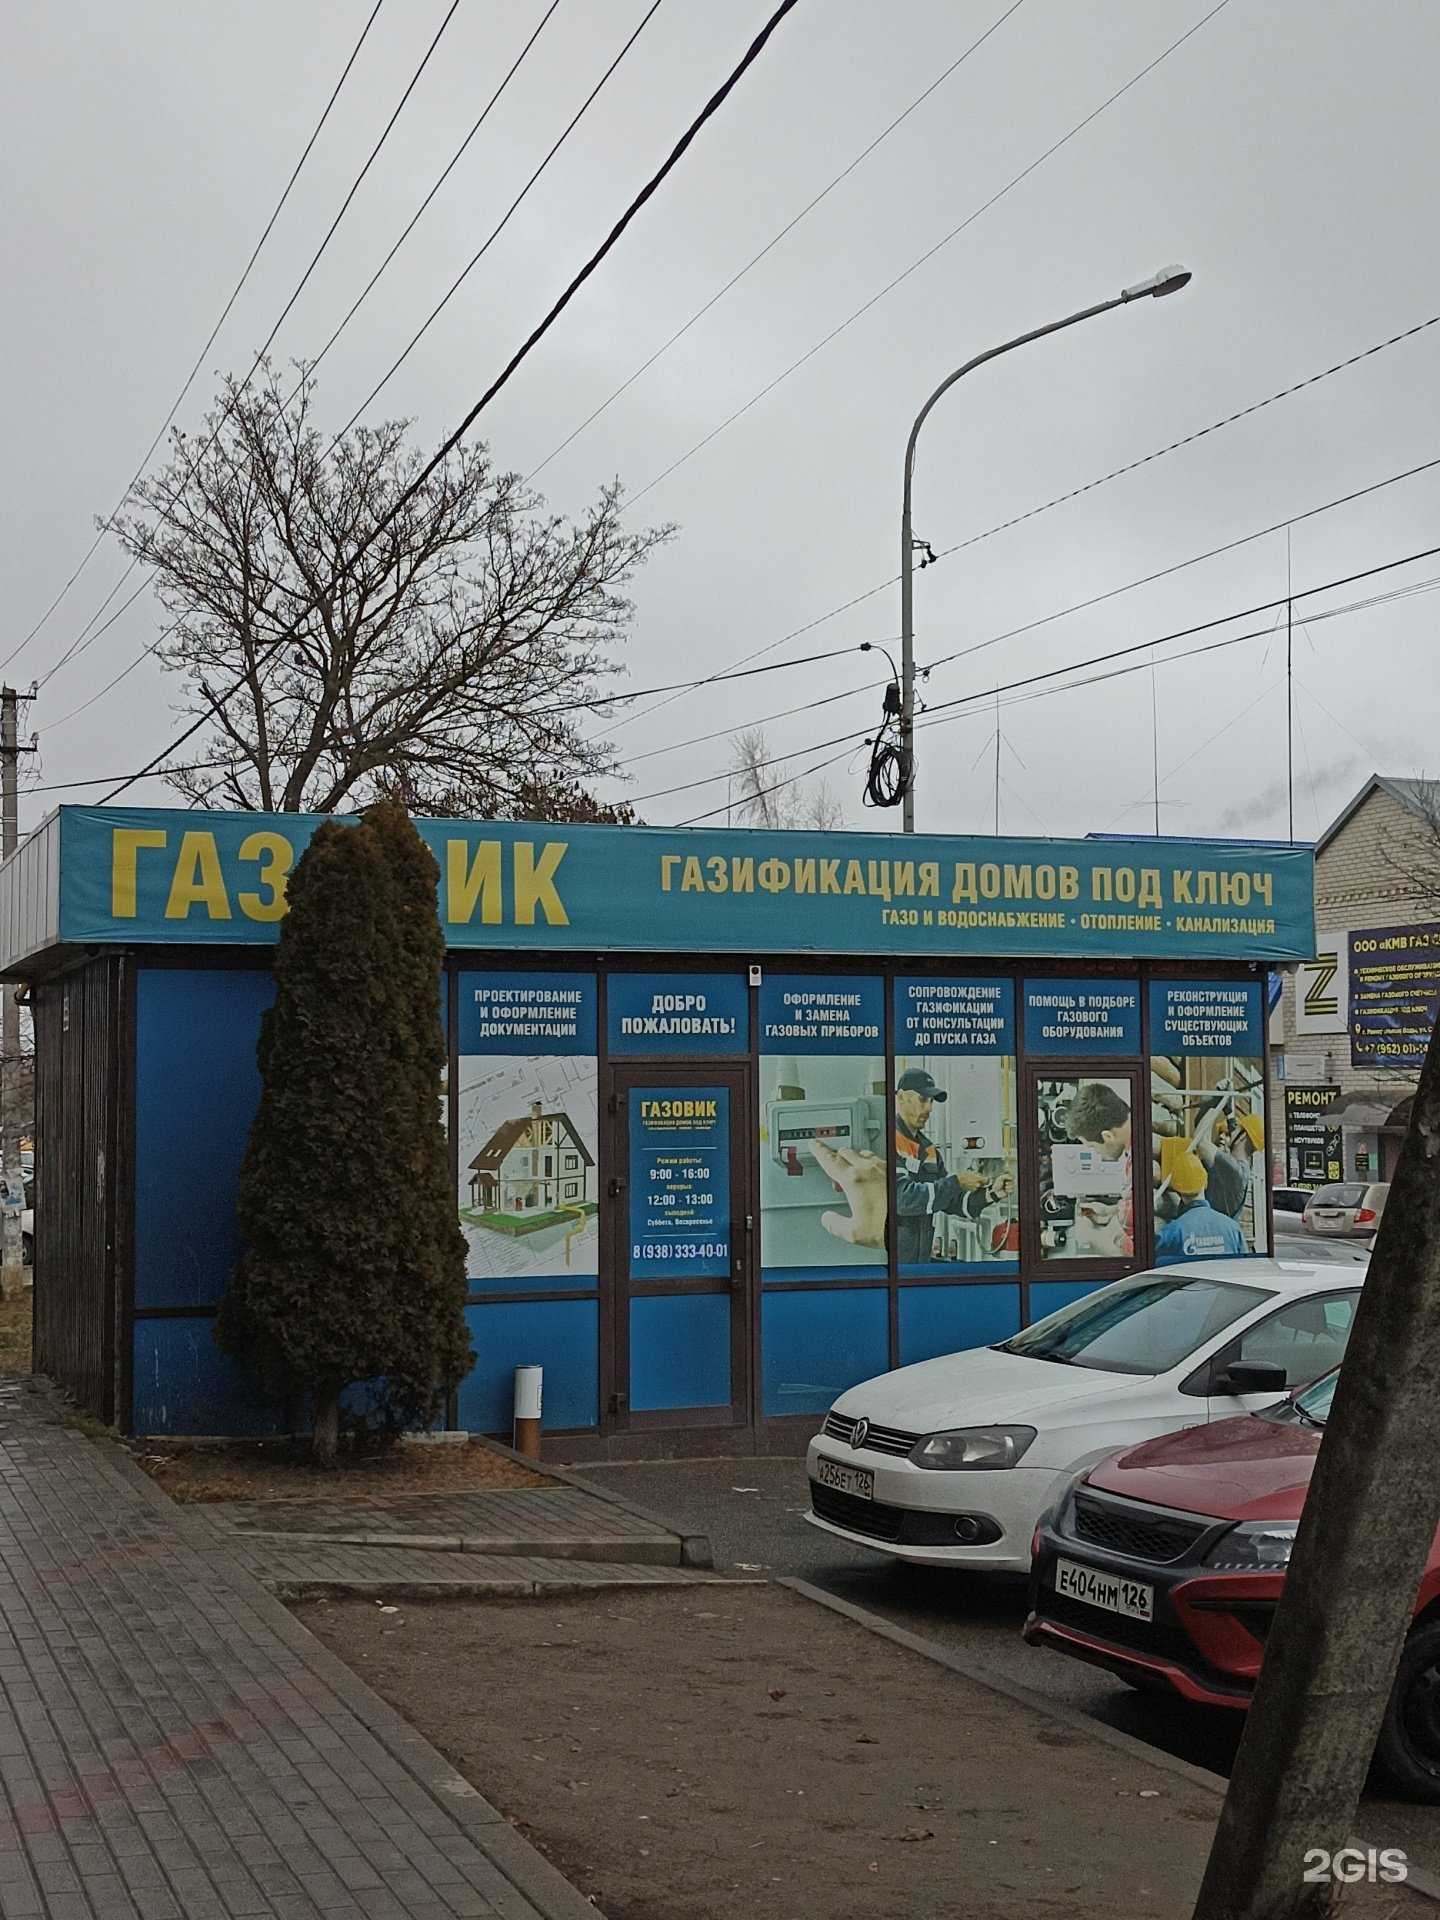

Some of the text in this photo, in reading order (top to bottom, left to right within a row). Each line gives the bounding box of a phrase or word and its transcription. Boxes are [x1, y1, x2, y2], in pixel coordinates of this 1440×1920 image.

[111, 827, 570, 926] ГАЗИК
[661, 855, 1273, 909] ГАЗИФИКАЦИЯ ДОМОВ ПОД КЛЮЧ
[882, 909, 1275, 936] ГАЗО И ВОДОСНАБЖЕНИЕ ОТОПЛЕНИЕ КАНАЛИЗАЦИЯ
[474, 988, 582, 1004] ПРОЕКТИРОВАНИЕ
[783, 992, 862, 1007] ОФОРМЛЕНИЕ
[908, 985, 1002, 1000] СОПРОВОЖДЕНИЕ
[1167, 990, 1248, 1004] РЕКОНСТРУКЦИЯ
[652, 994, 707, 1015] ДОБРО
[916, 1001, 994, 1015] ГАЗИФИКАЦИИ
[1028, 995, 1136, 1010] ПОМОЩЬ В ПОДБОРЕ
[480, 1006, 577, 1020] И ОФОРМЛЕНИЕ
[795, 1008, 850, 1022] И ЗАМЕНА
[1057, 1010, 1109, 1024] ГАЗОВОГО
[1168, 1005, 1245, 1018] И ОФОРМЛЕНИЕ
[479, 1021, 577, 1038] ДОКУМЕНТАЦИИ
[621, 1016, 736, 1035] ПОЖАЛОВАТЬ!
[906, 1016, 1005, 1031] ОТ КОНСУЛЬТАЦИИ
[1164, 1019, 1249, 1033] СУЩЕСТВУЮЩИХ
[764, 1024, 880, 1039] ГАЗОВЫХ ПРИБОРОВ
[914, 1032, 997, 1046] ДО ПУСКА ГАЗА
[1042, 1025, 1124, 1040] ОБОРУДОВАНИЯ
[1182, 1034, 1232, 1047] ОБЪЕКТОВ
[1288, 1091, 1337, 1106] РЕМОНТ
[641, 1100, 717, 1117] ГАЗОВИК
[650, 1168, 672, 1180] 9:00
[681, 1167, 710, 1179] 16:00
[647, 1194, 675, 1206] 12:00
[685, 1194, 713, 1205] 13:00
[633, 1244, 728, 1259] 8 (938) 333-40-01
[1121, 1583, 1147, 1609] 126
